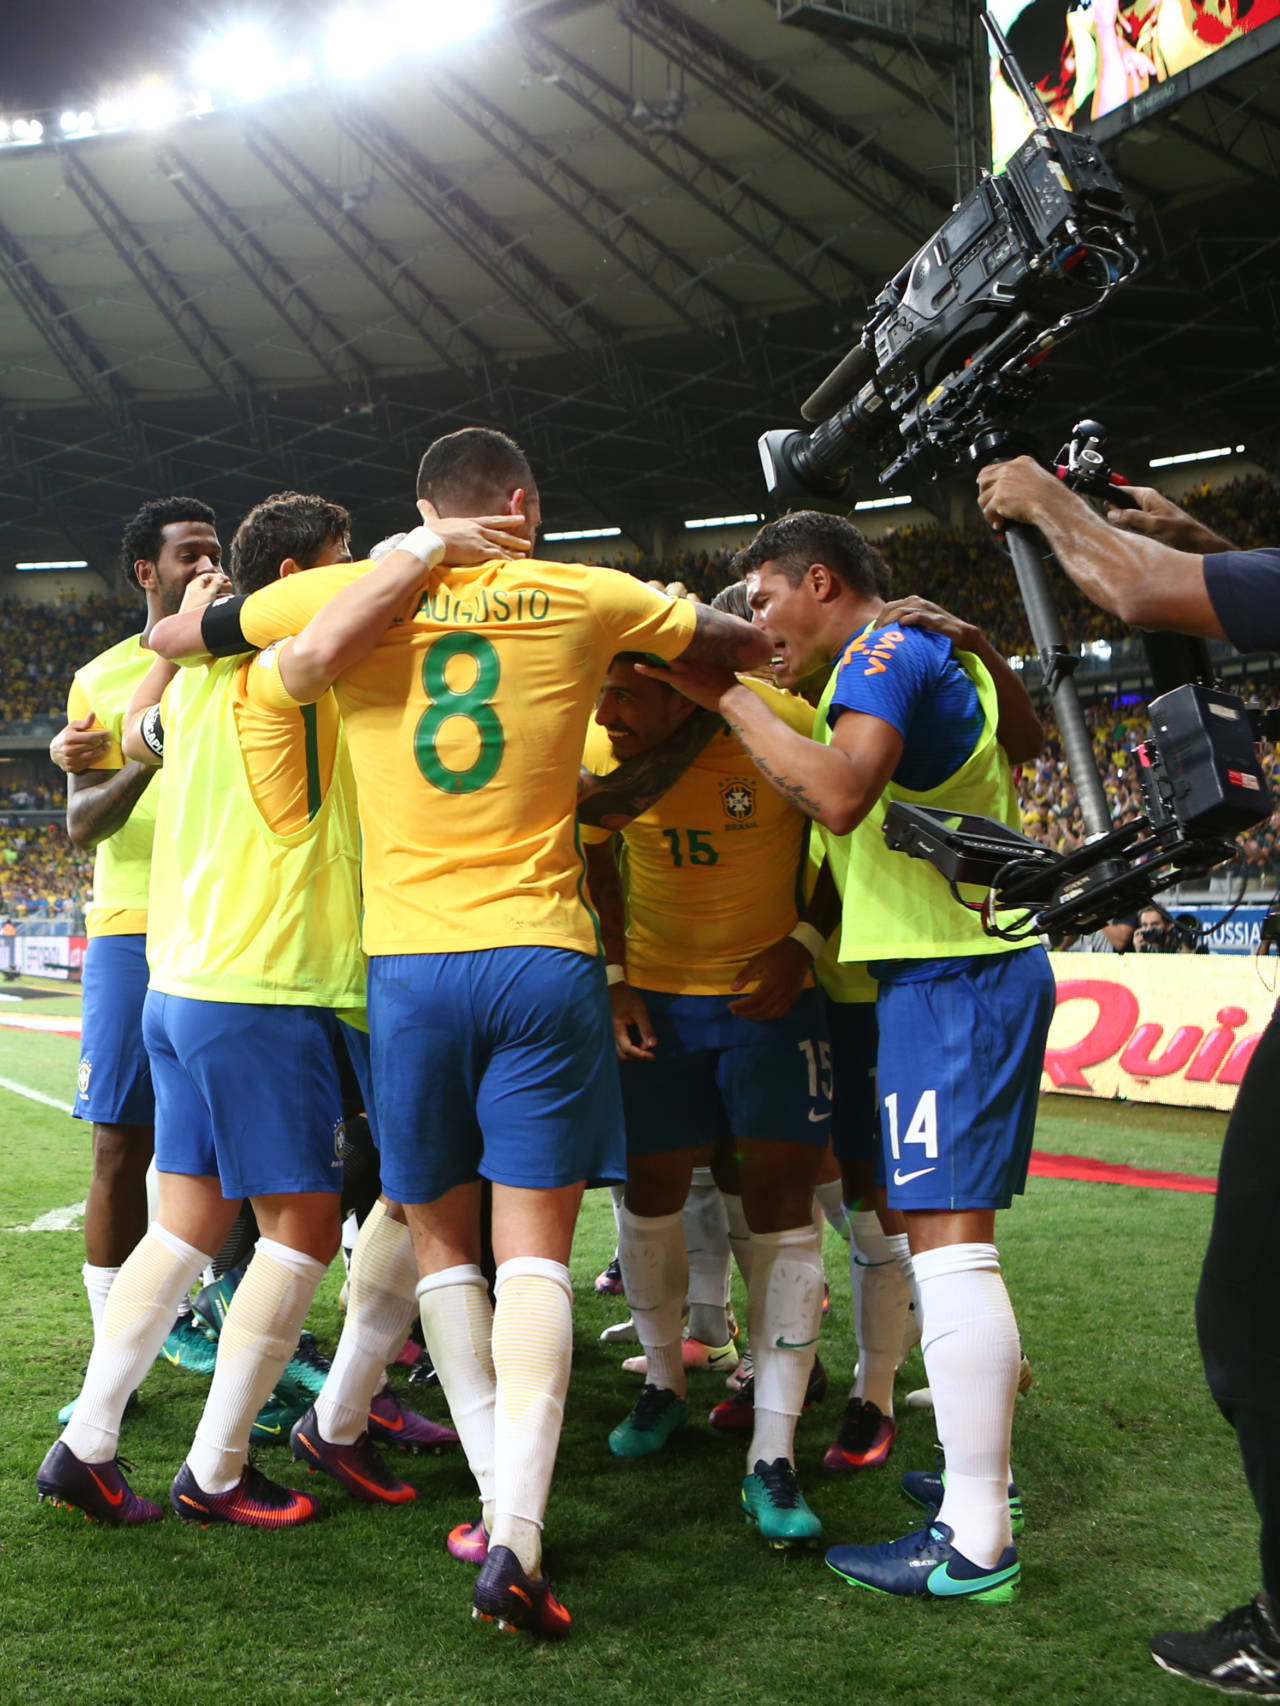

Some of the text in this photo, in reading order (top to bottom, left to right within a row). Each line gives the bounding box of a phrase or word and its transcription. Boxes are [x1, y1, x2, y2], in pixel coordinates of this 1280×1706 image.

[416, 588, 550, 624] AUGUSTO
[414, 630, 505, 795] 8
[662, 828, 719, 868] 15
[1202, 921, 1262, 945] RUSSIA
[884, 1089, 939, 1160] 14
